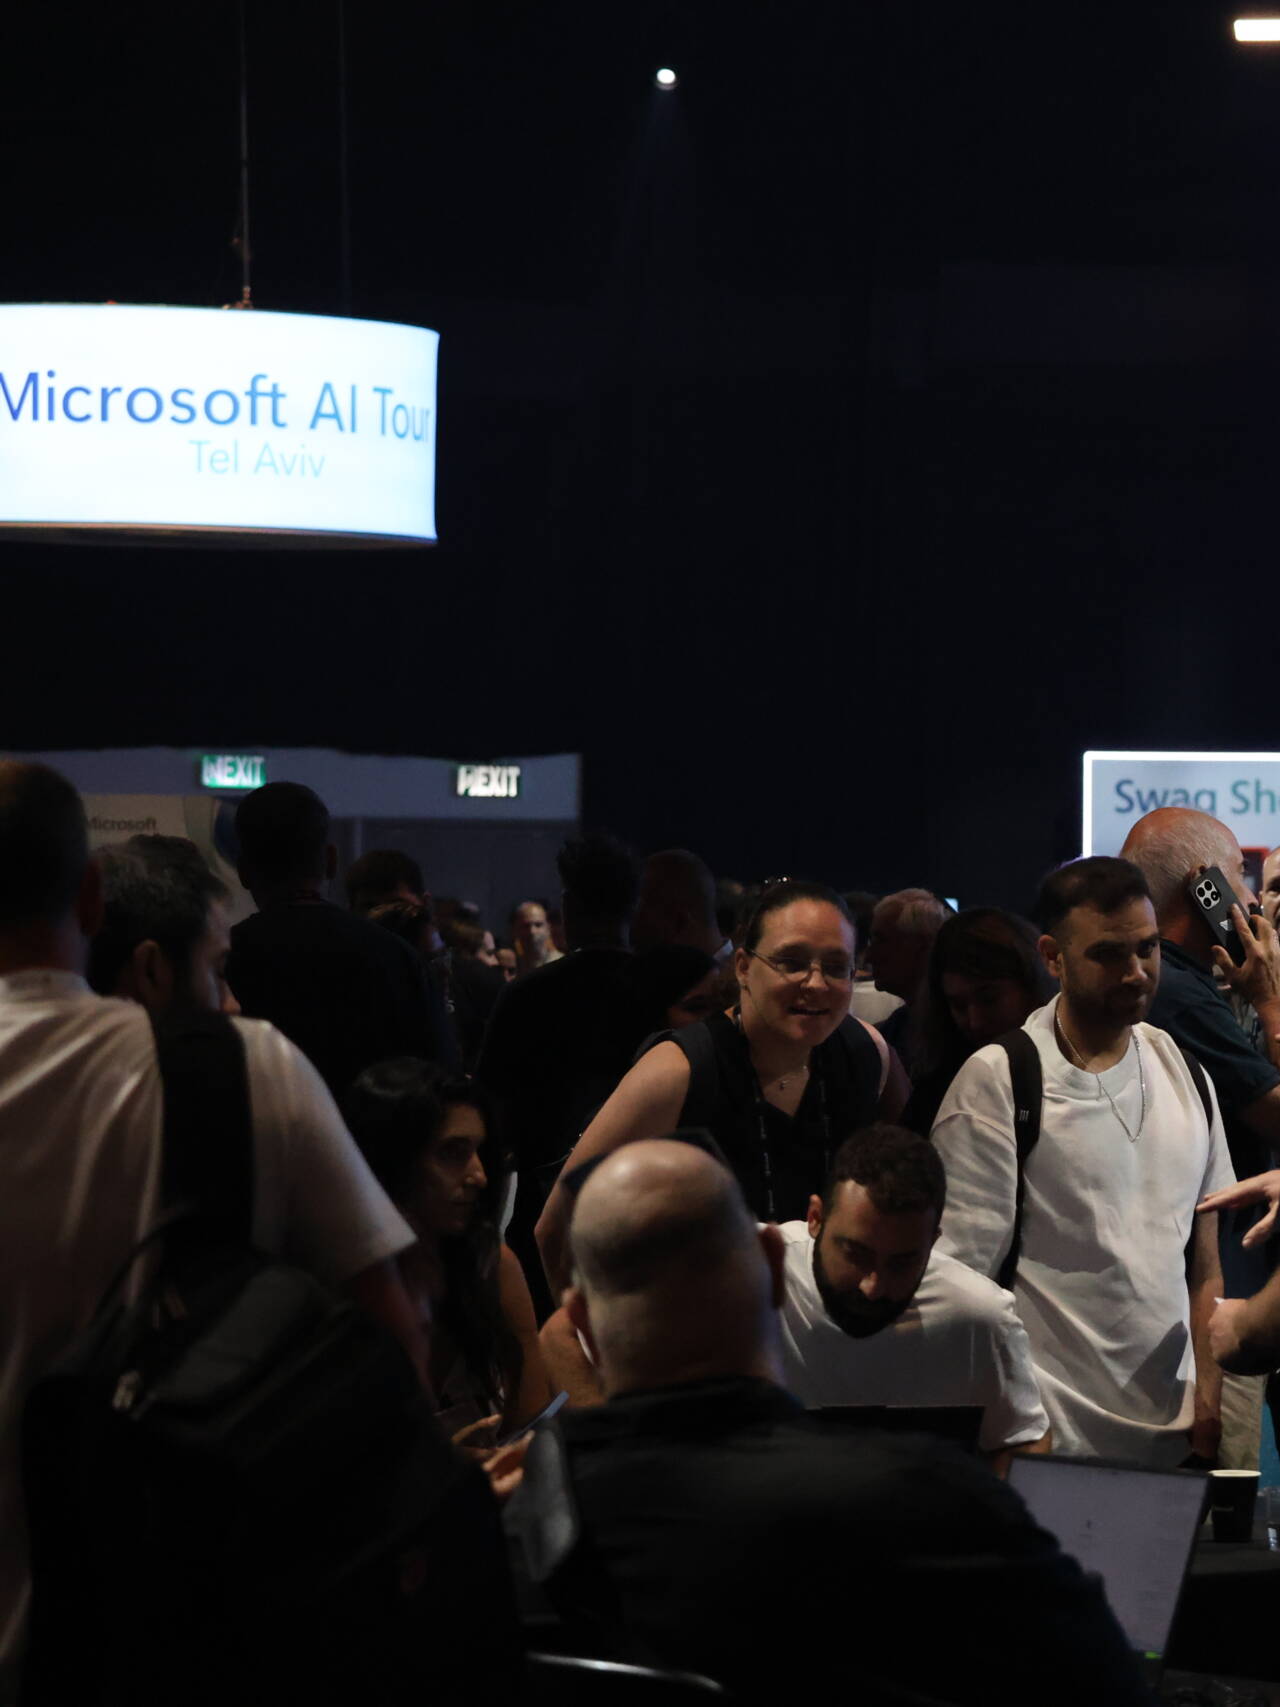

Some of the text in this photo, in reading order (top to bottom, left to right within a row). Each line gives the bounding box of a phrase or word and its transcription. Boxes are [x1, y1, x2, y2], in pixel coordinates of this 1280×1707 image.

[0, 370, 430, 442] Microsoft AI Tour
[188, 439, 326, 478] Tel Aviv
[222, 756, 264, 787] EXIT
[477, 765, 520, 797] EXIT
